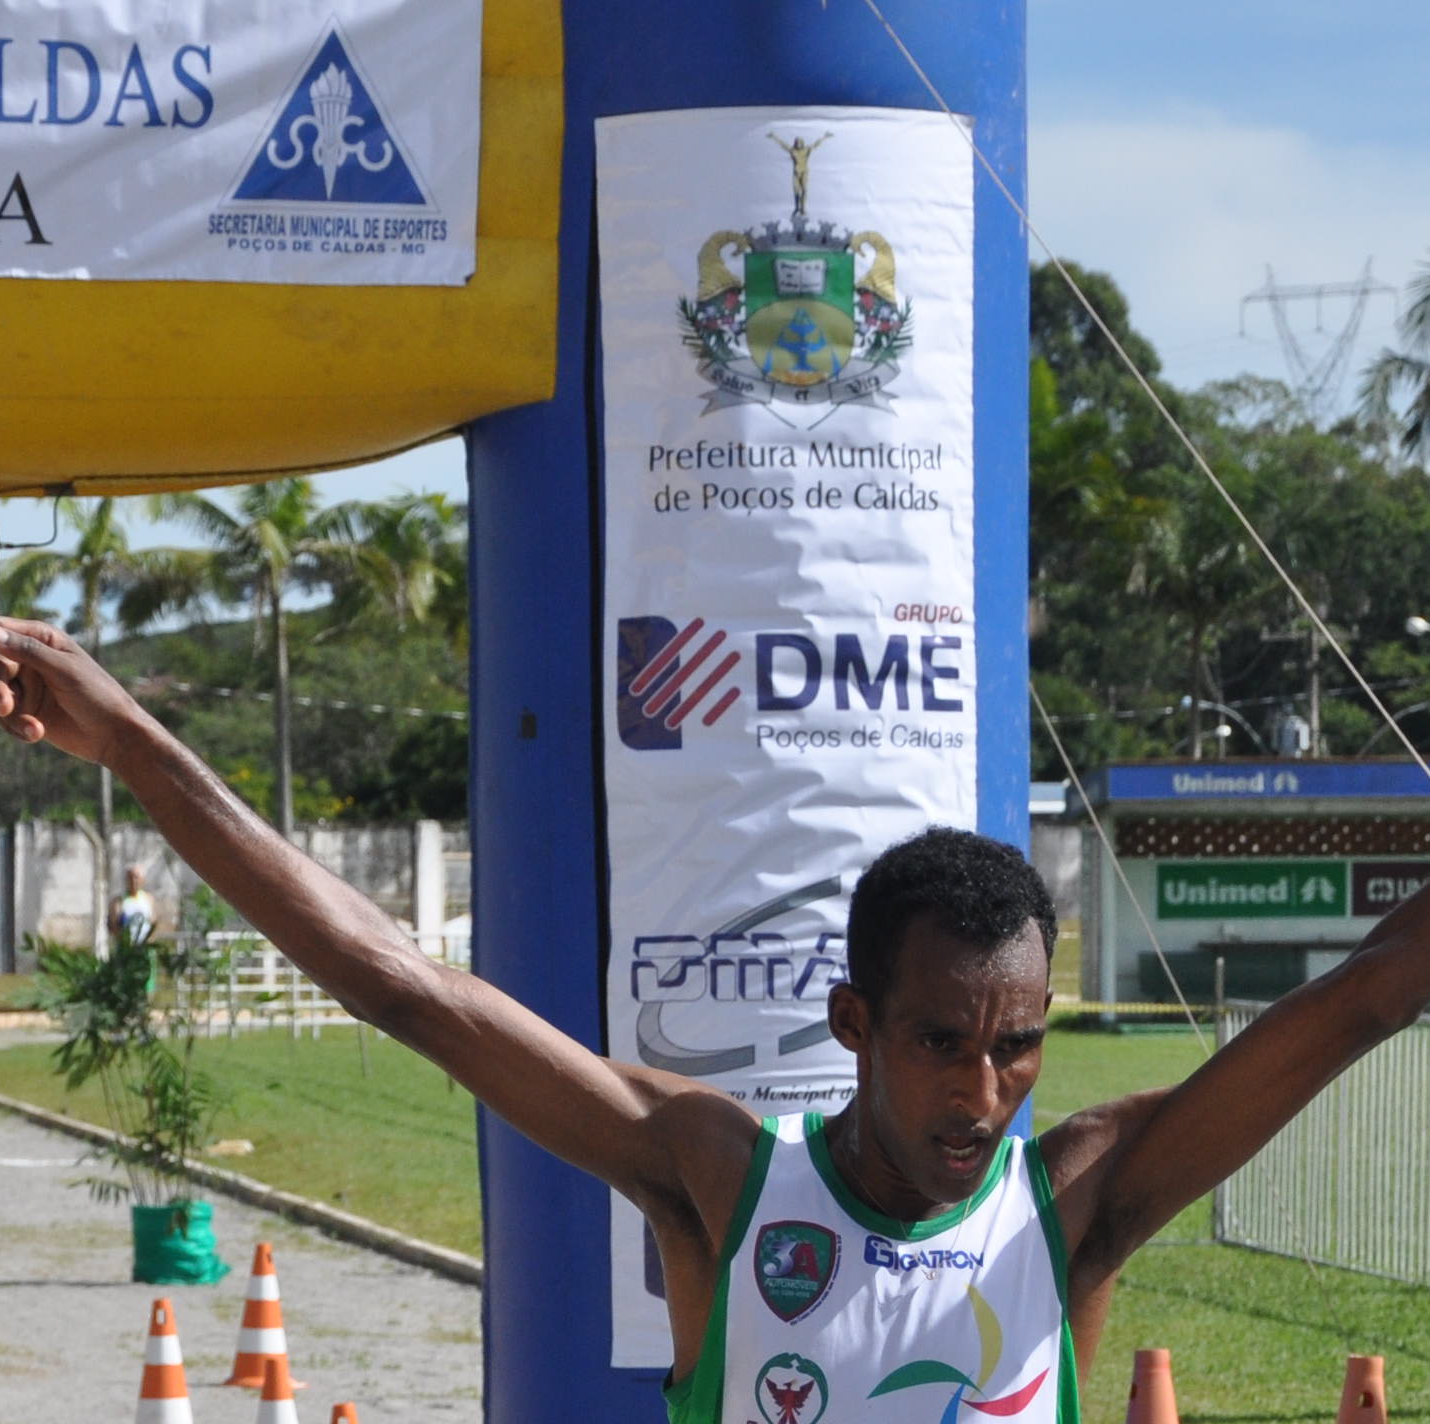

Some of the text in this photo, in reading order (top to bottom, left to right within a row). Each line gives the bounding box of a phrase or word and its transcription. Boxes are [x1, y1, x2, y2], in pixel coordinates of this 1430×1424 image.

[208, 213, 448, 242] SECRETARIA MUNICIPAL DE ESPORTES
[227, 237, 286, 252] POÇOS
[293, 240, 313, 252] DE
[321, 240, 385, 254] CALDAS
[401, 242, 426, 255] MG
[649, 440, 942, 475] Prefeitura Municipal
[653, 481, 939, 517] de Poços de Caldas
[893, 602, 964, 625] GRUPO
[755, 632, 964, 713] DME
[756, 724, 964, 754] Poços de Caldas
[1173, 771, 1264, 793] Unimed
[1164, 876, 1288, 905] Unimed
